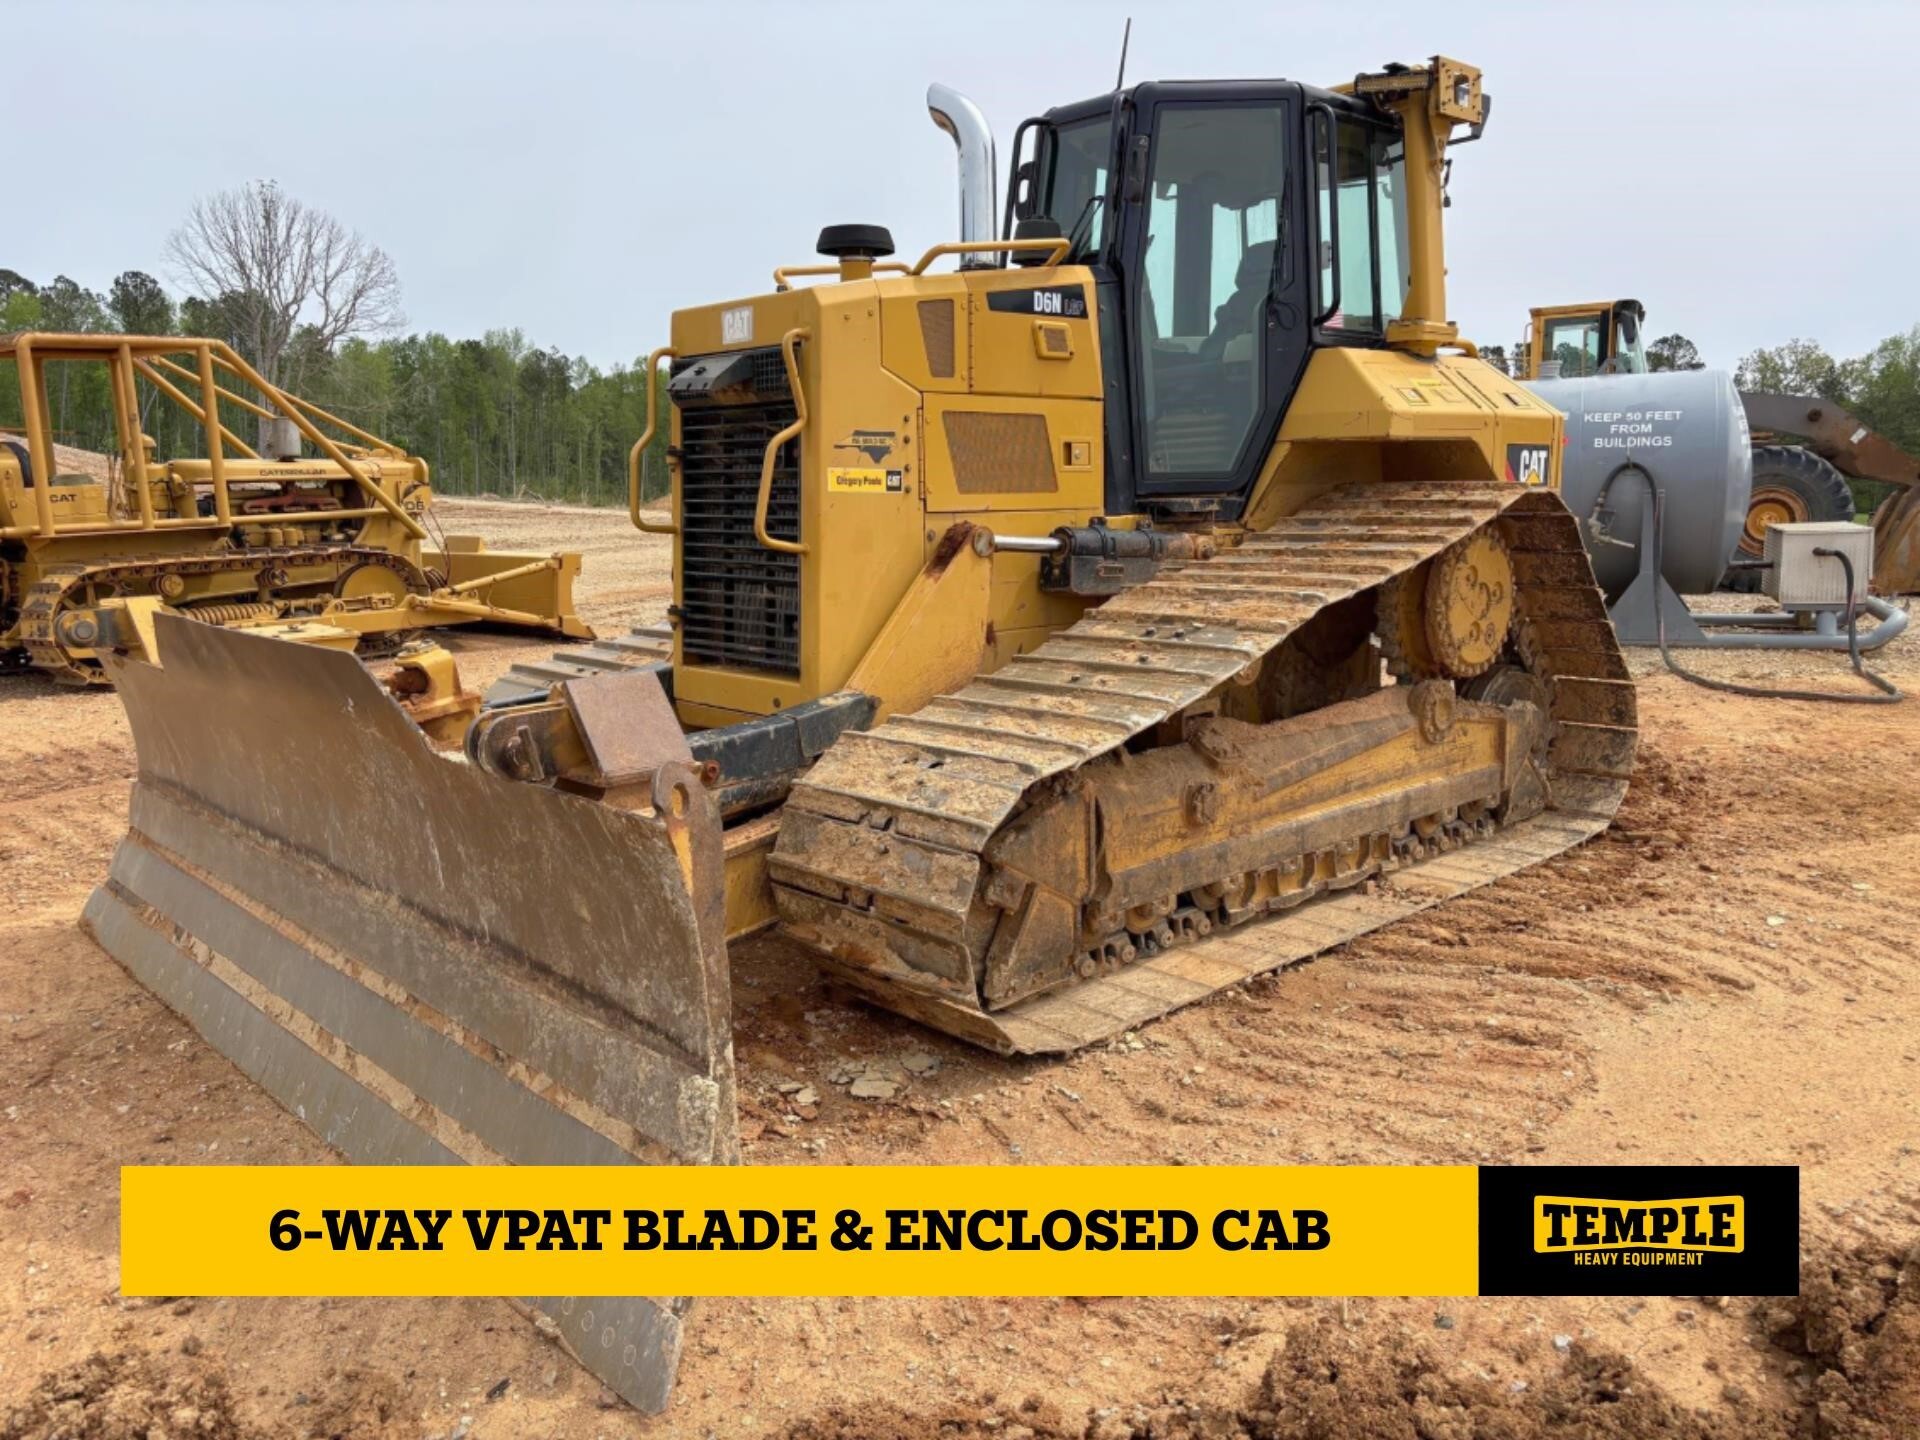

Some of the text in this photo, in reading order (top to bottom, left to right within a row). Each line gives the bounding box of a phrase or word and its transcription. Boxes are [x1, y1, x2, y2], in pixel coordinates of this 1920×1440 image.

[1033, 290, 1062, 314] D6N
[723, 309, 752, 340] CAT
[1584, 410, 1683, 423] KEEP 50 FEET
[1609, 423, 1653, 434] FROM
[1593, 436, 1673, 448] BUILDINGS
[1520, 449, 1548, 483] CAT
[259, 468, 327, 477] CATERPILLAR
[49, 494, 77, 503] CAT
[405, 500, 424, 511] D6
